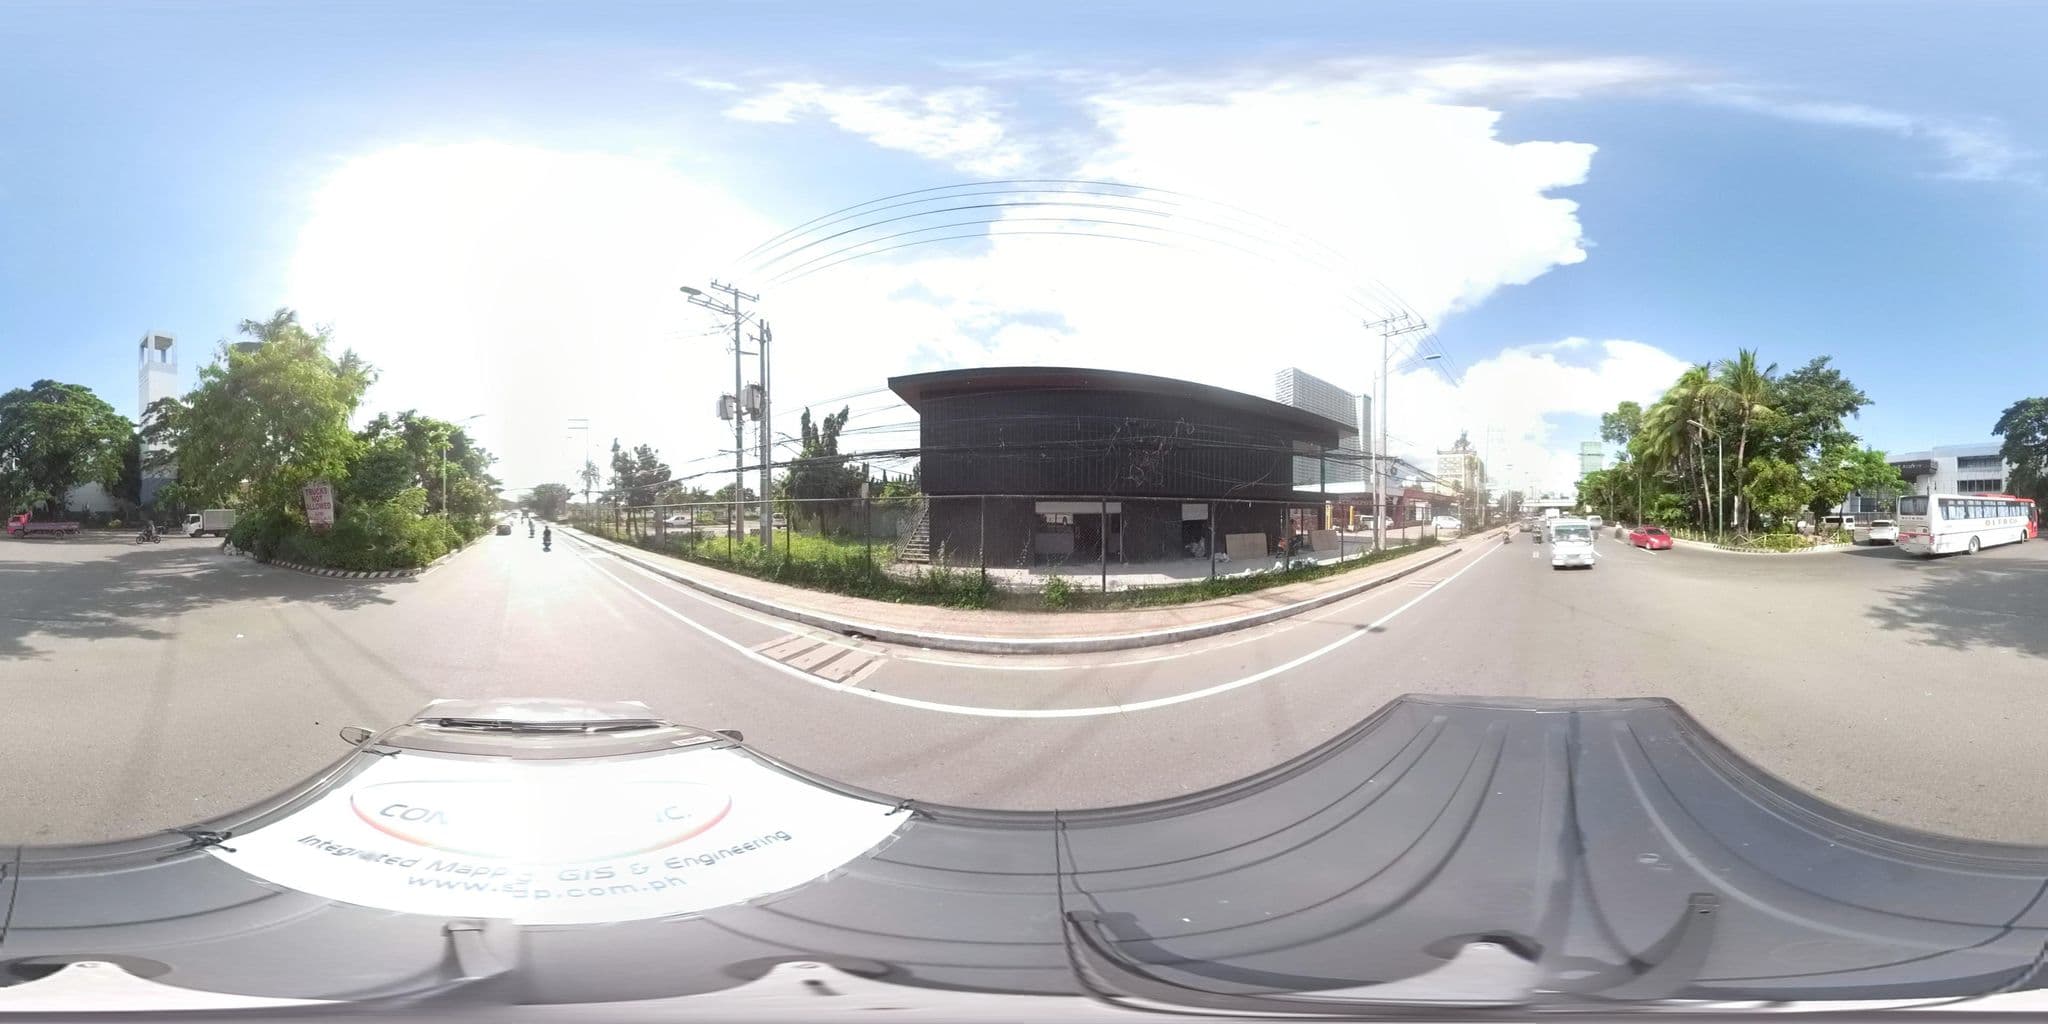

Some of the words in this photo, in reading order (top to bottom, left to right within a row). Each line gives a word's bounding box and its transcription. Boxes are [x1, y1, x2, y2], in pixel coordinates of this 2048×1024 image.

[311, 495, 322, 503] NOT
[306, 502, 331, 511] ALLOWED
[557, 865, 616, 882] GIS
[664, 829, 793, 870] Engineering
